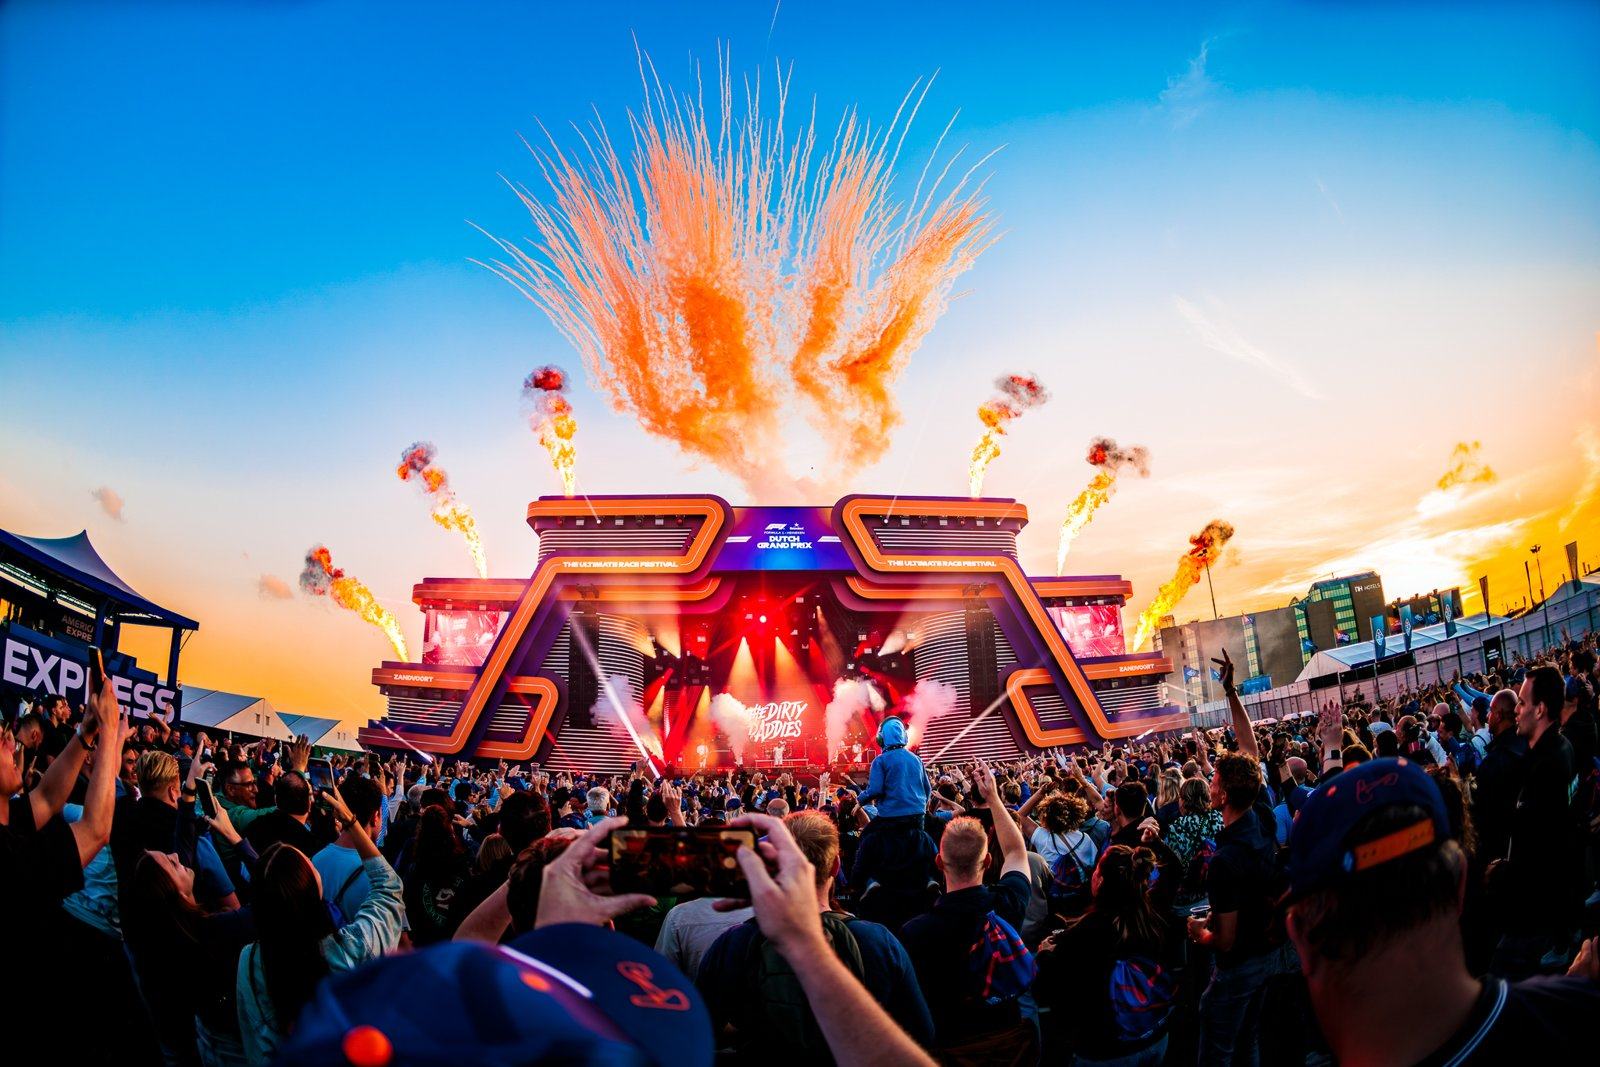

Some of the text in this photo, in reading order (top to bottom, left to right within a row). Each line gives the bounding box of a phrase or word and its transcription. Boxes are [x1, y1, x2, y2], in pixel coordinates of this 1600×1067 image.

[393, 673, 434, 683] ZANDVOORT
[1118, 663, 1155, 673] ZANDVOORT
[3, 637, 176, 724] EXPESS
[764, 701, 808, 721] DIRTY
[747, 719, 803, 743] DADDIES
